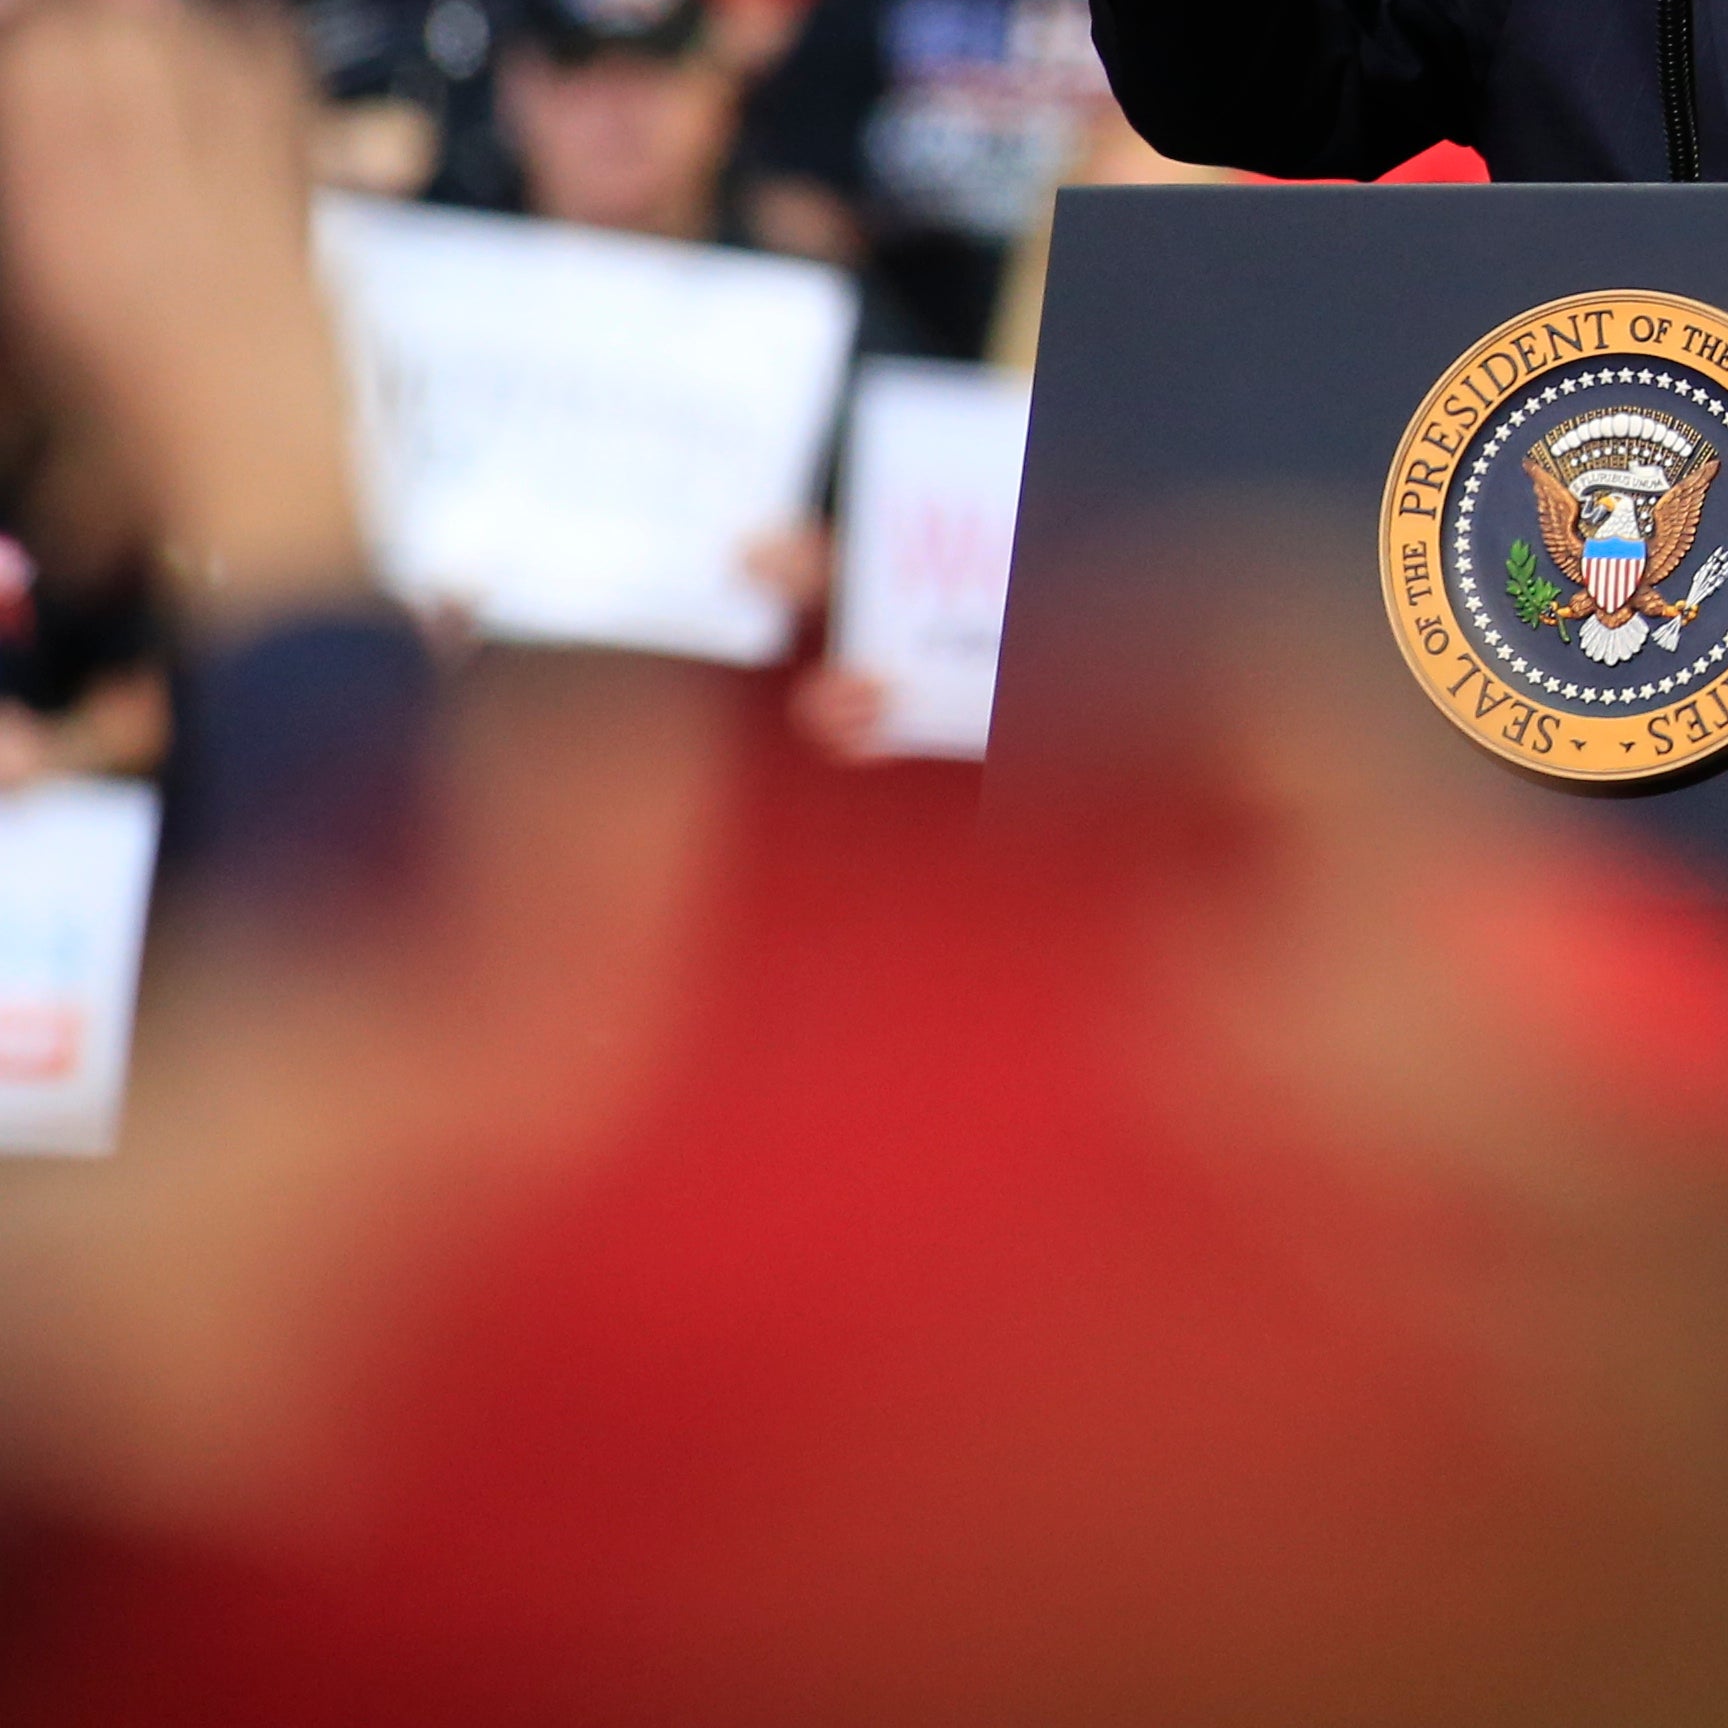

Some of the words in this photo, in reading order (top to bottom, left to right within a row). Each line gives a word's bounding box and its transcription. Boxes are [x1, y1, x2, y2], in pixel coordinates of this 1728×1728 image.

[1629, 314, 1673, 345] OF
[1400, 309, 1614, 521] PRESIDENT
[1402, 539, 1432, 606] THE
[1415, 616, 1450, 656] OF
[1446, 653, 1561, 754] SEAL
